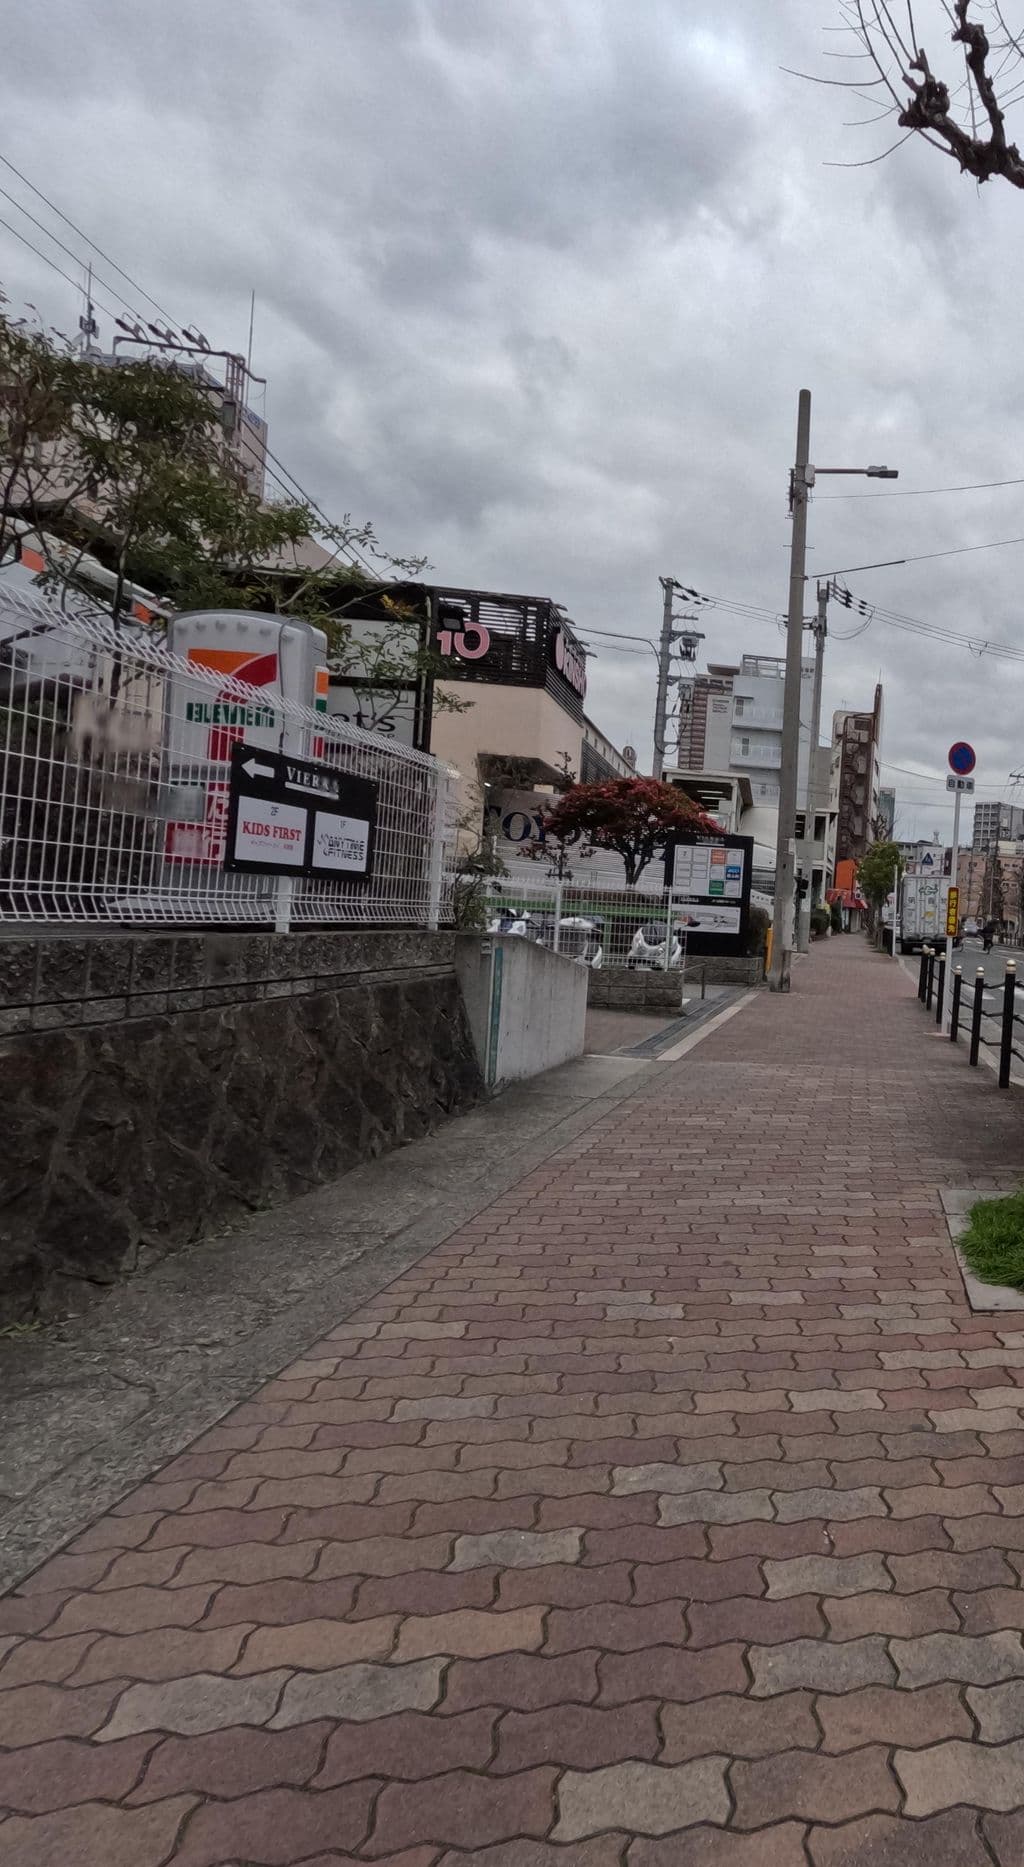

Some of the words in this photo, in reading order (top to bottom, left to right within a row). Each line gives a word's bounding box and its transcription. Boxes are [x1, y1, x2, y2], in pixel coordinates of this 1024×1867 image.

[286, 765, 340, 793] VIER
[242, 821, 270, 838] KIDS
[272, 825, 302, 842] FIRST
[327, 847, 364, 861] FITNESS
